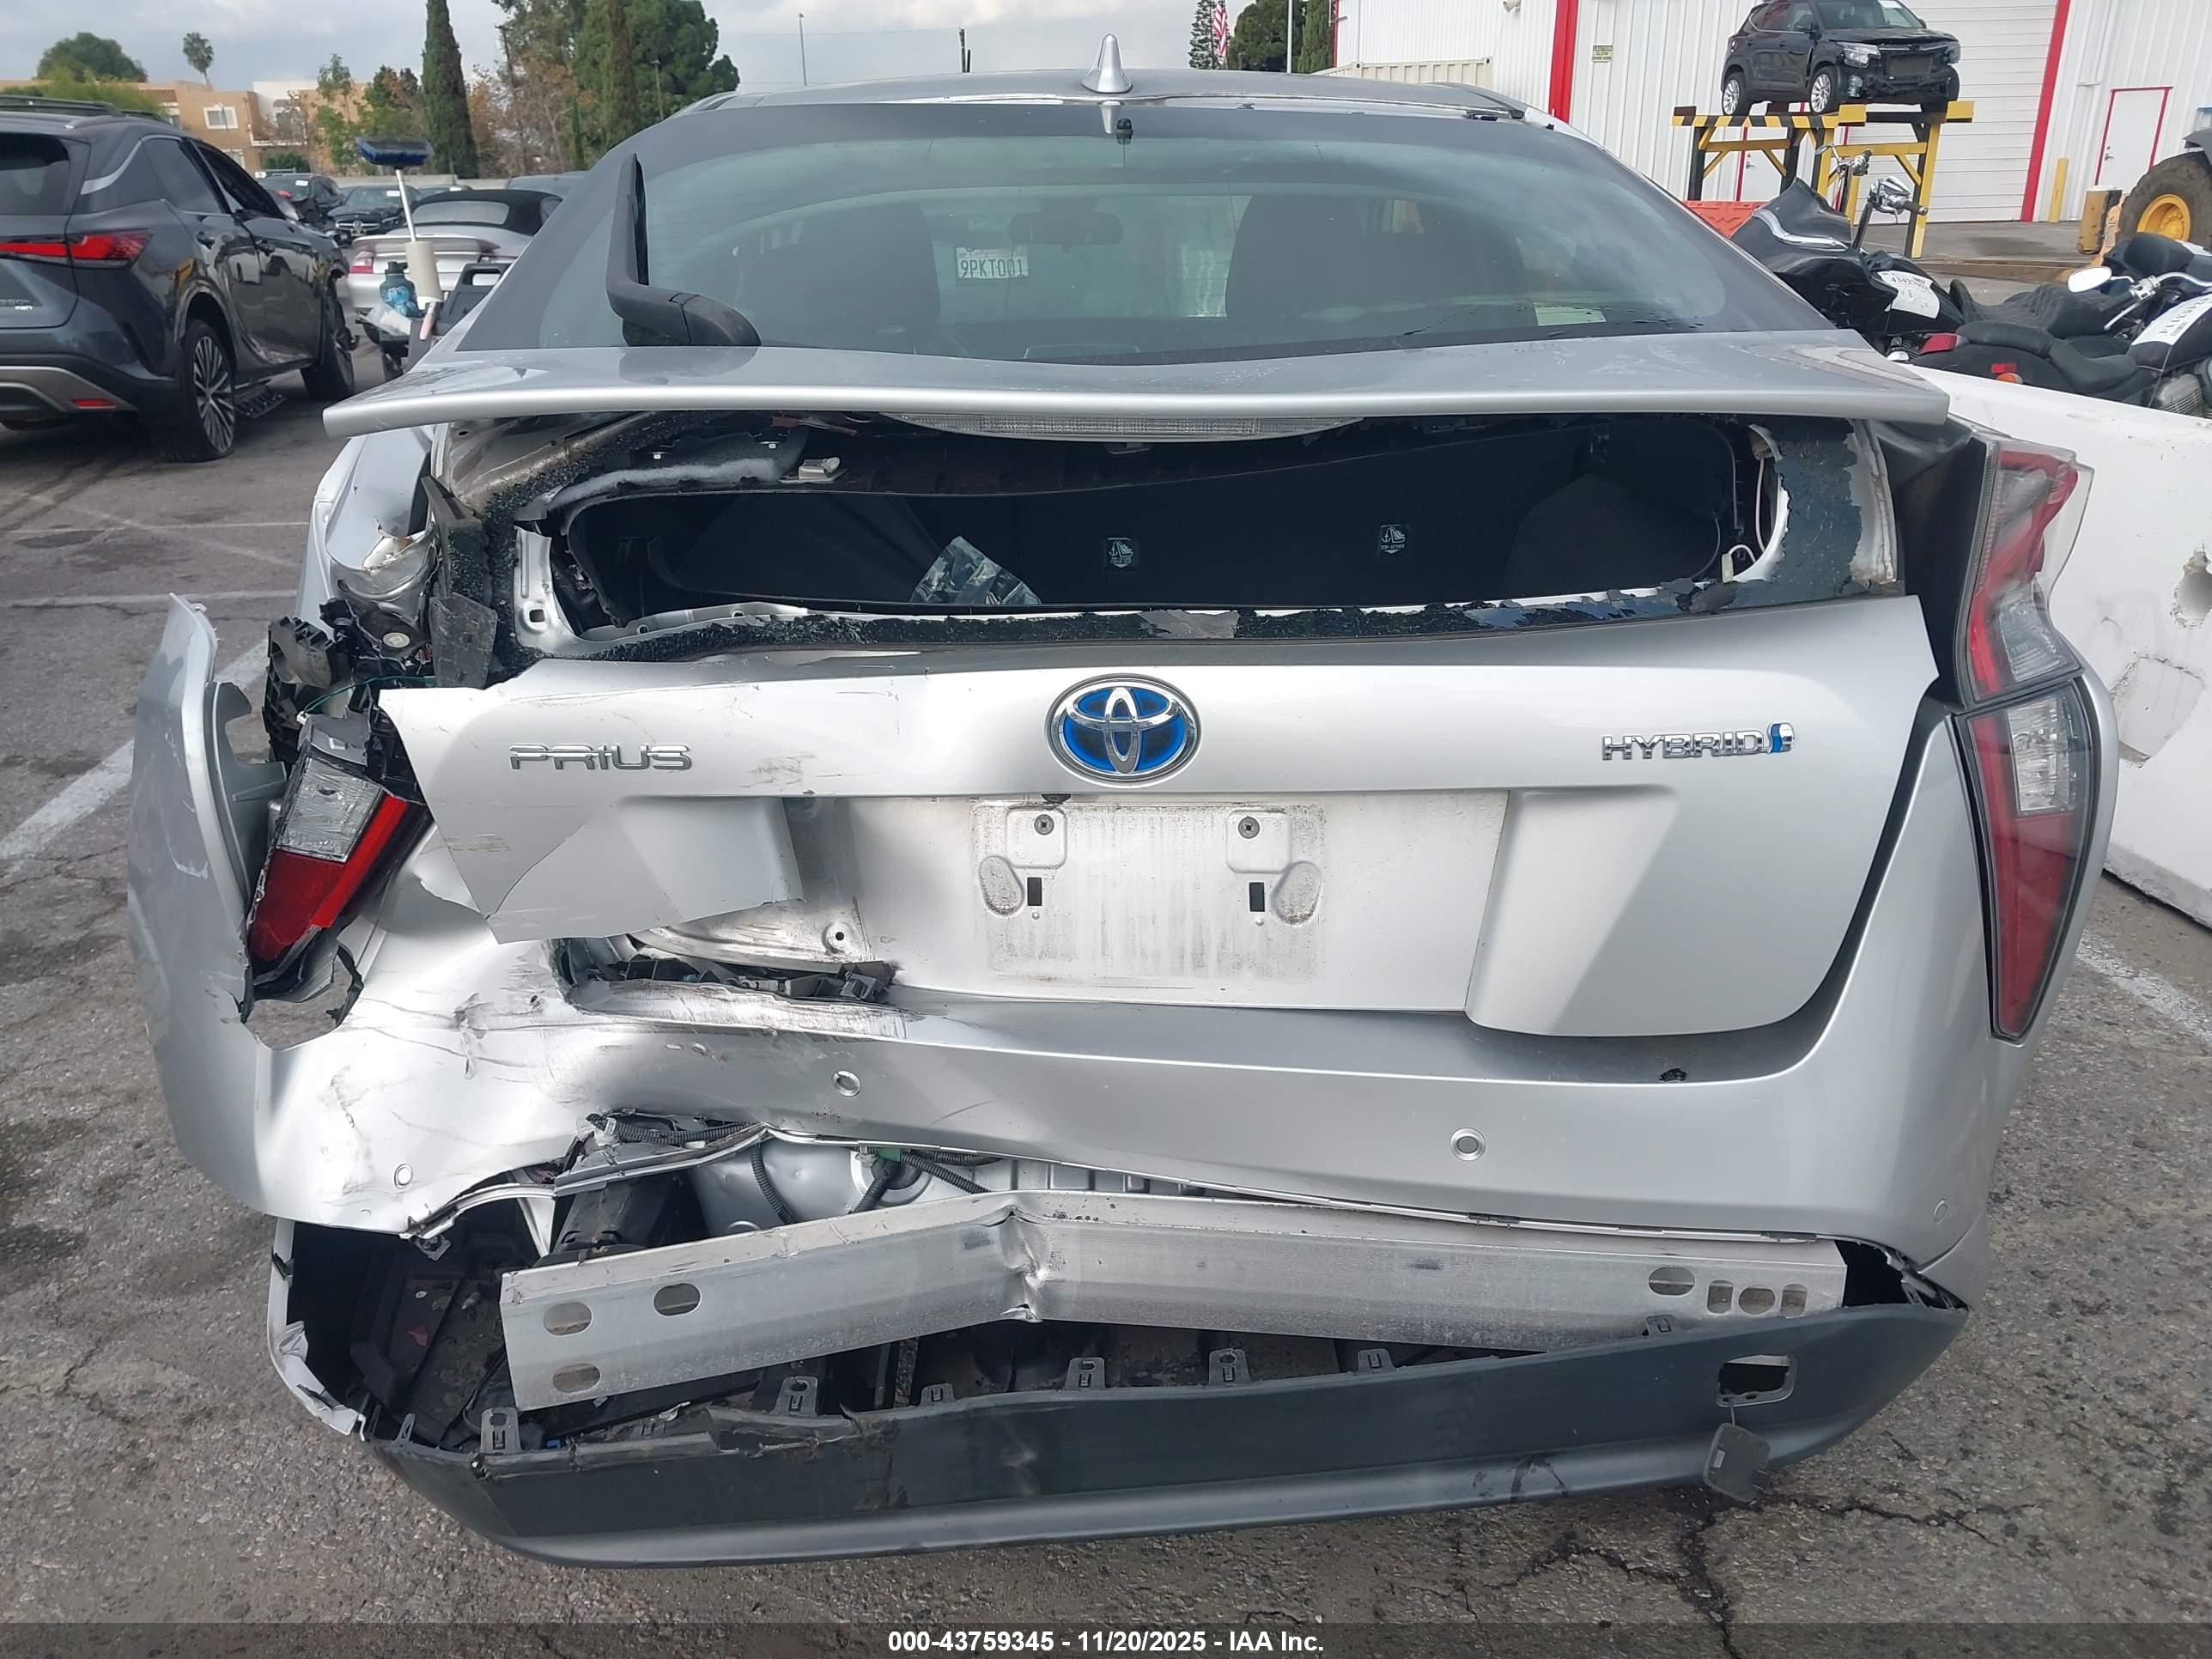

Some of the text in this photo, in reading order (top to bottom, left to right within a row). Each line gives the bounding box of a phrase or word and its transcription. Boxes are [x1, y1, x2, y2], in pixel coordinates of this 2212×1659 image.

[960, 258, 1024, 277] 9PKT001
[508, 744, 692, 769] PRIUS
[1601, 730, 1764, 761] HYBRID
